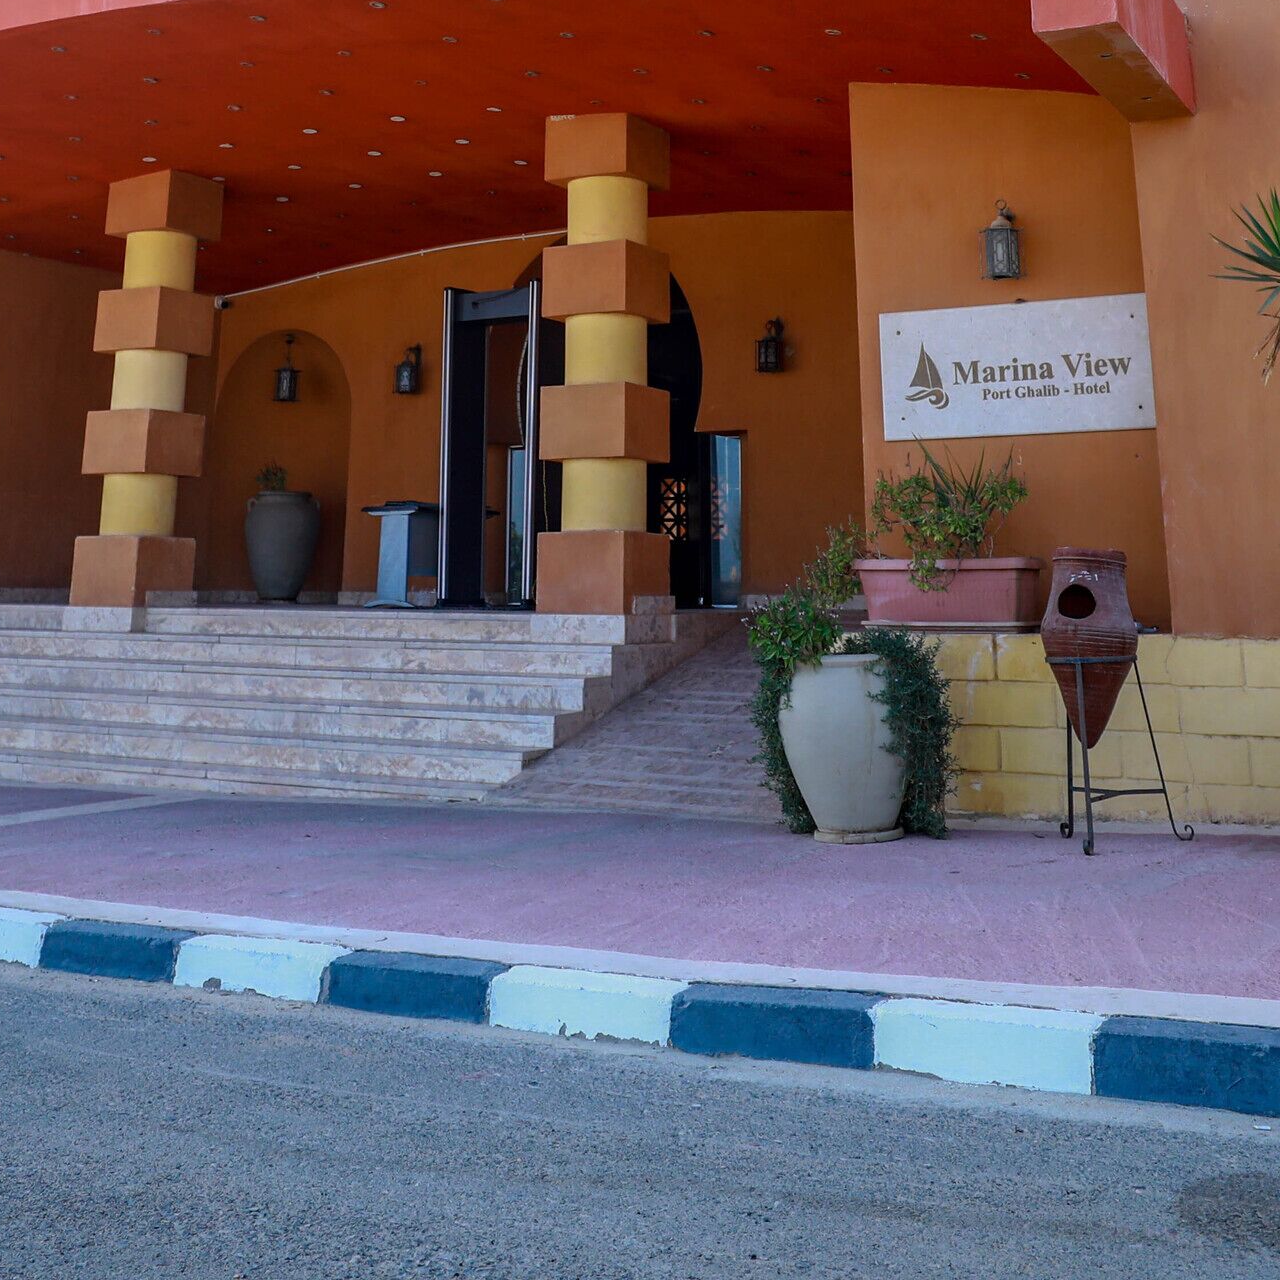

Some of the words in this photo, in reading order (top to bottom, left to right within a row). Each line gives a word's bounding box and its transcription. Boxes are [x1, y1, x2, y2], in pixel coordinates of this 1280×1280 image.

[952, 357, 1055, 386] Marina
[1061, 352, 1132, 379] View
[982, 386, 1011, 401] Port
[1014, 384, 1061, 399] Ghalib
[1073, 381, 1111, 396] Hotel
